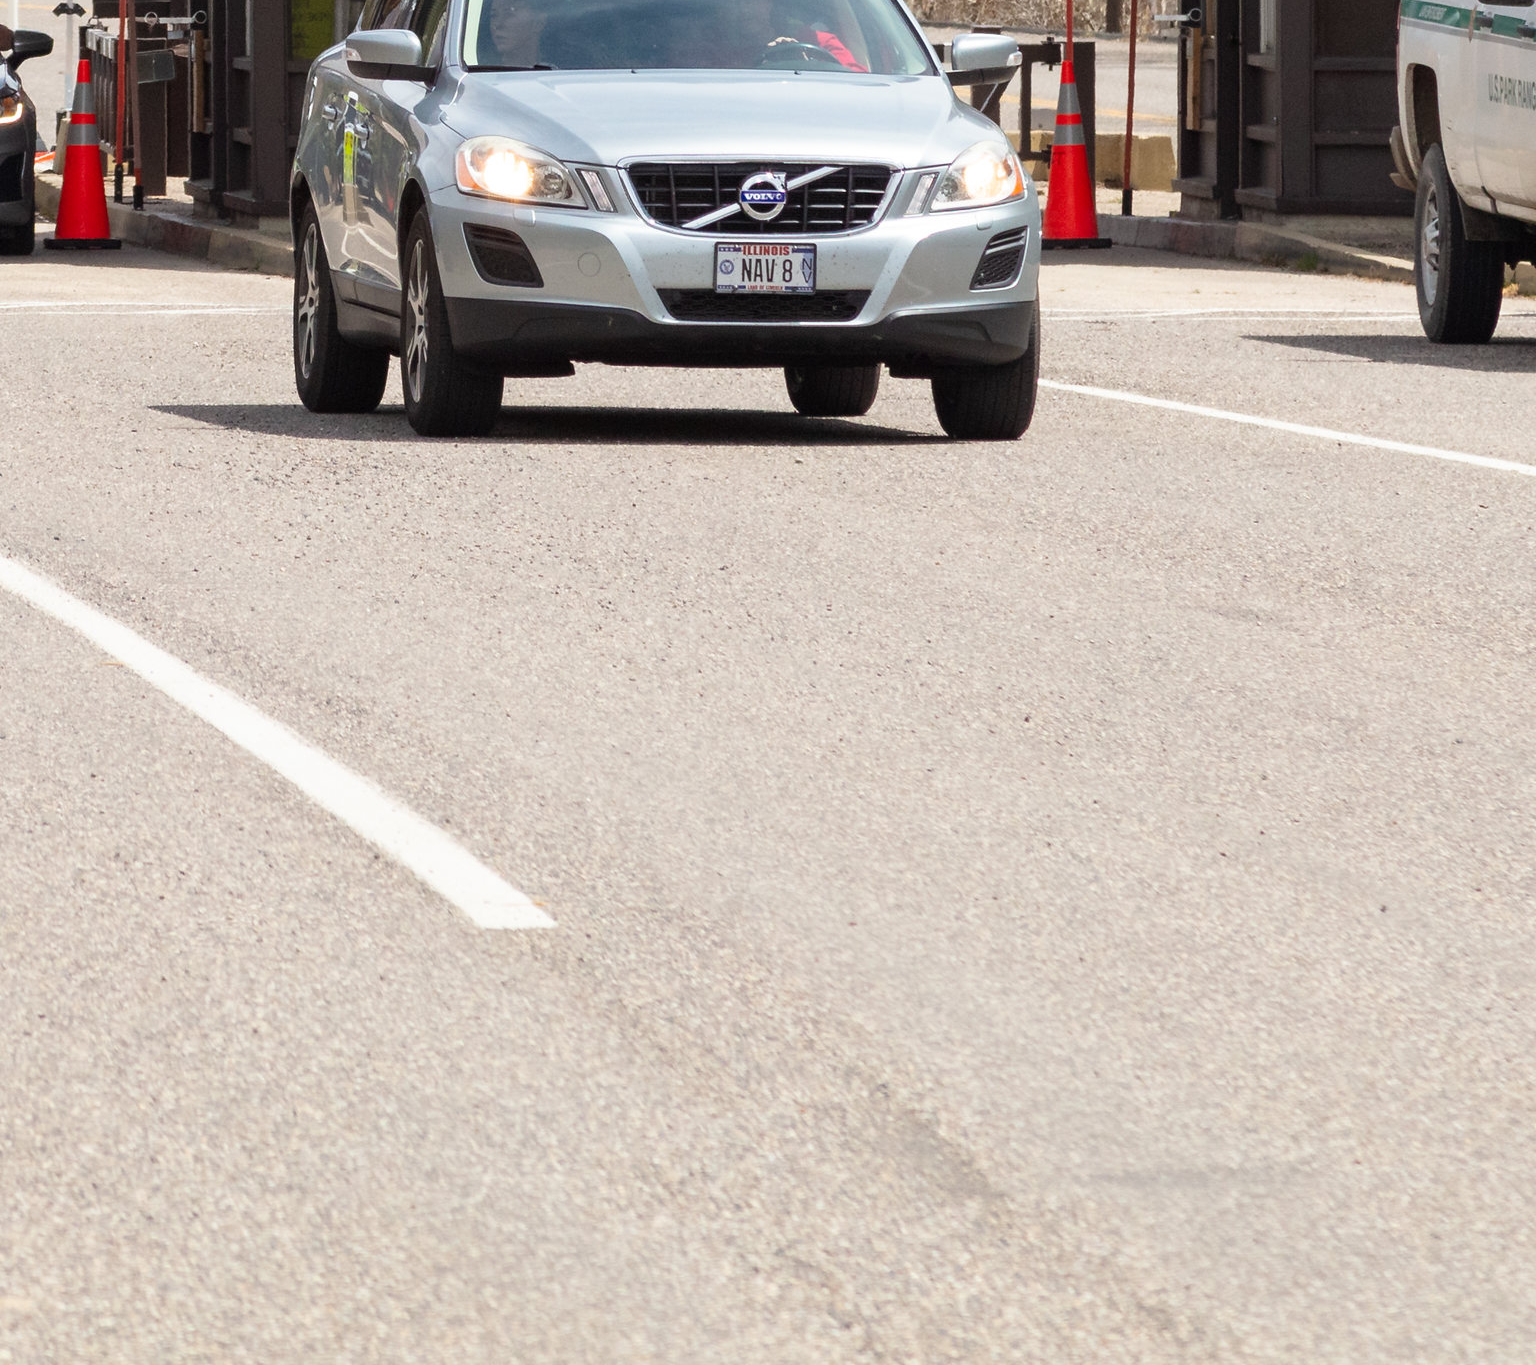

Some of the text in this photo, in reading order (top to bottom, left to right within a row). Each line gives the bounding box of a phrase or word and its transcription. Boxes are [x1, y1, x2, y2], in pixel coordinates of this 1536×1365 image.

[1499, 75, 1518, 107] PARK
[743, 193, 783, 201] VOLVO
[742, 244, 790, 256] ILLINOIS
[741, 258, 793, 283] NAV 8
